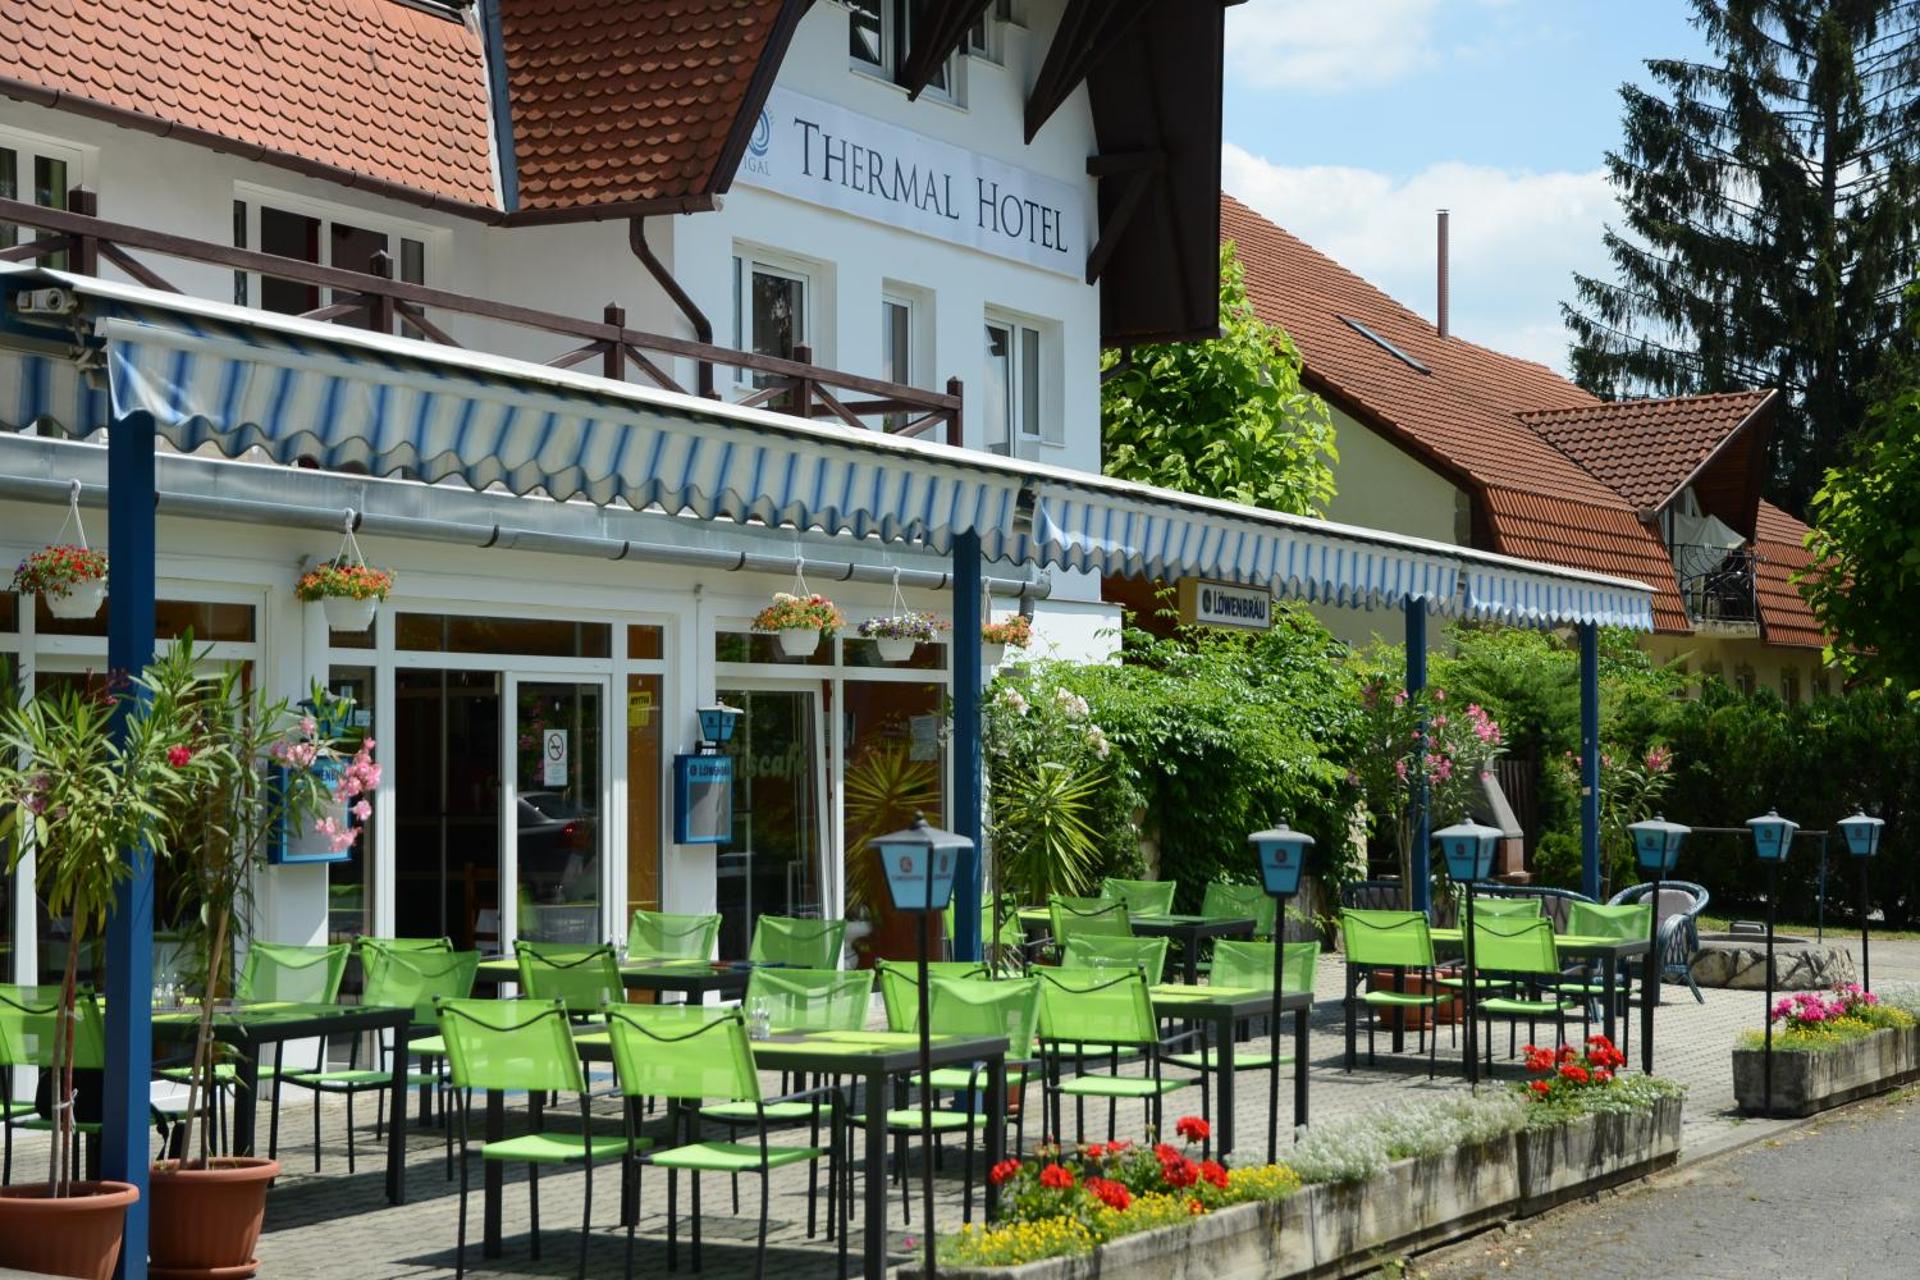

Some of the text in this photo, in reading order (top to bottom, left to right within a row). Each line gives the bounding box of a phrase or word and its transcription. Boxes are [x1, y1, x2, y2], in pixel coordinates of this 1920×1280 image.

[794, 117, 1068, 253] THERMAL HOTEL
[1213, 589, 1266, 620] LÖWENBRÄU
